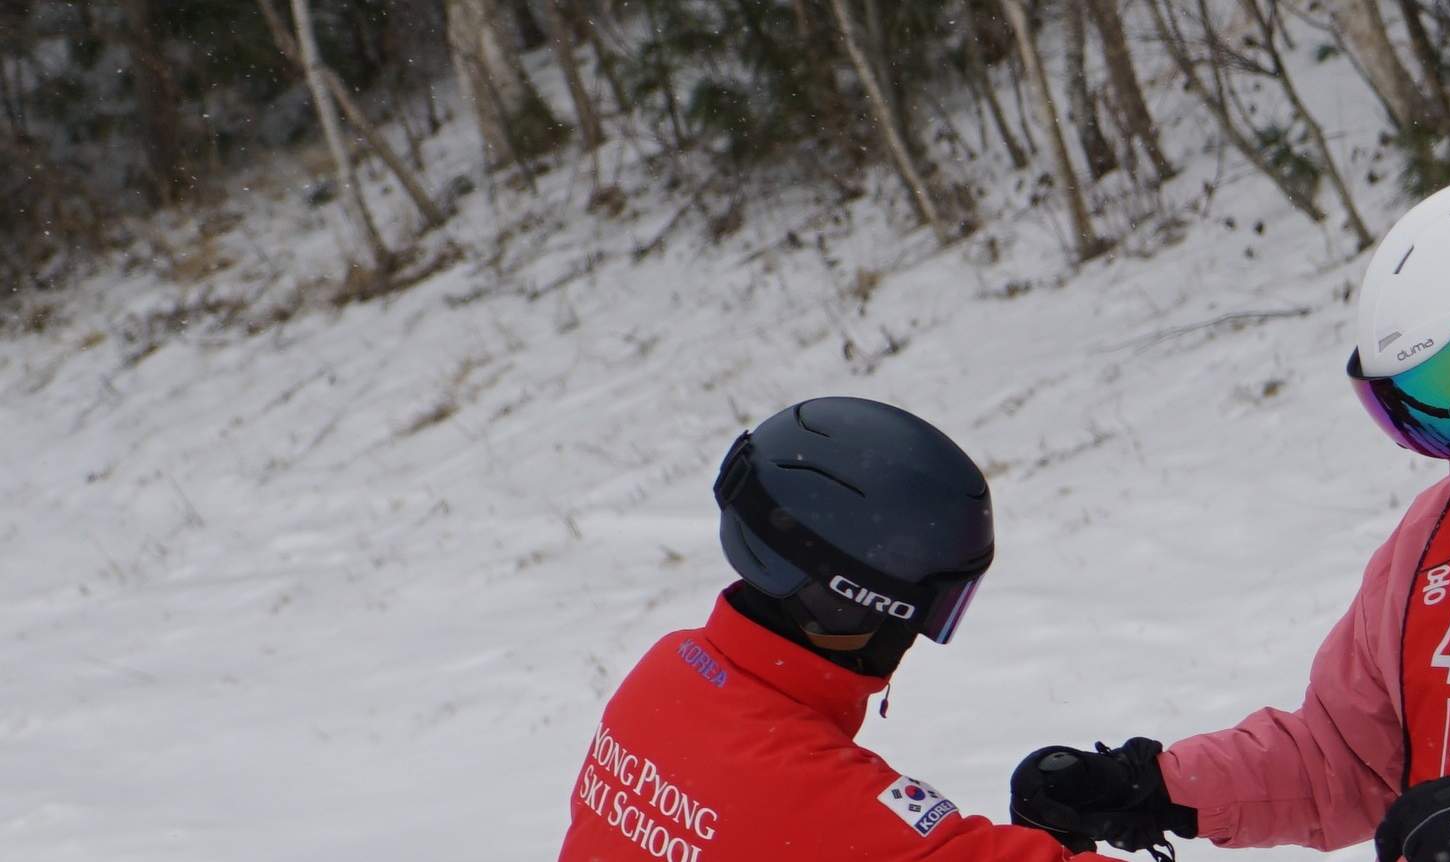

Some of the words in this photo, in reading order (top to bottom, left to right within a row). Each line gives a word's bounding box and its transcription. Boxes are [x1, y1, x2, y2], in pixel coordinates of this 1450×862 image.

[829, 574, 916, 620] GIRO
[677, 638, 728, 689] KOREA
[579, 764, 611, 826] SKI
[592, 722, 638, 786] YONG
[633, 758, 718, 840] PYONG
